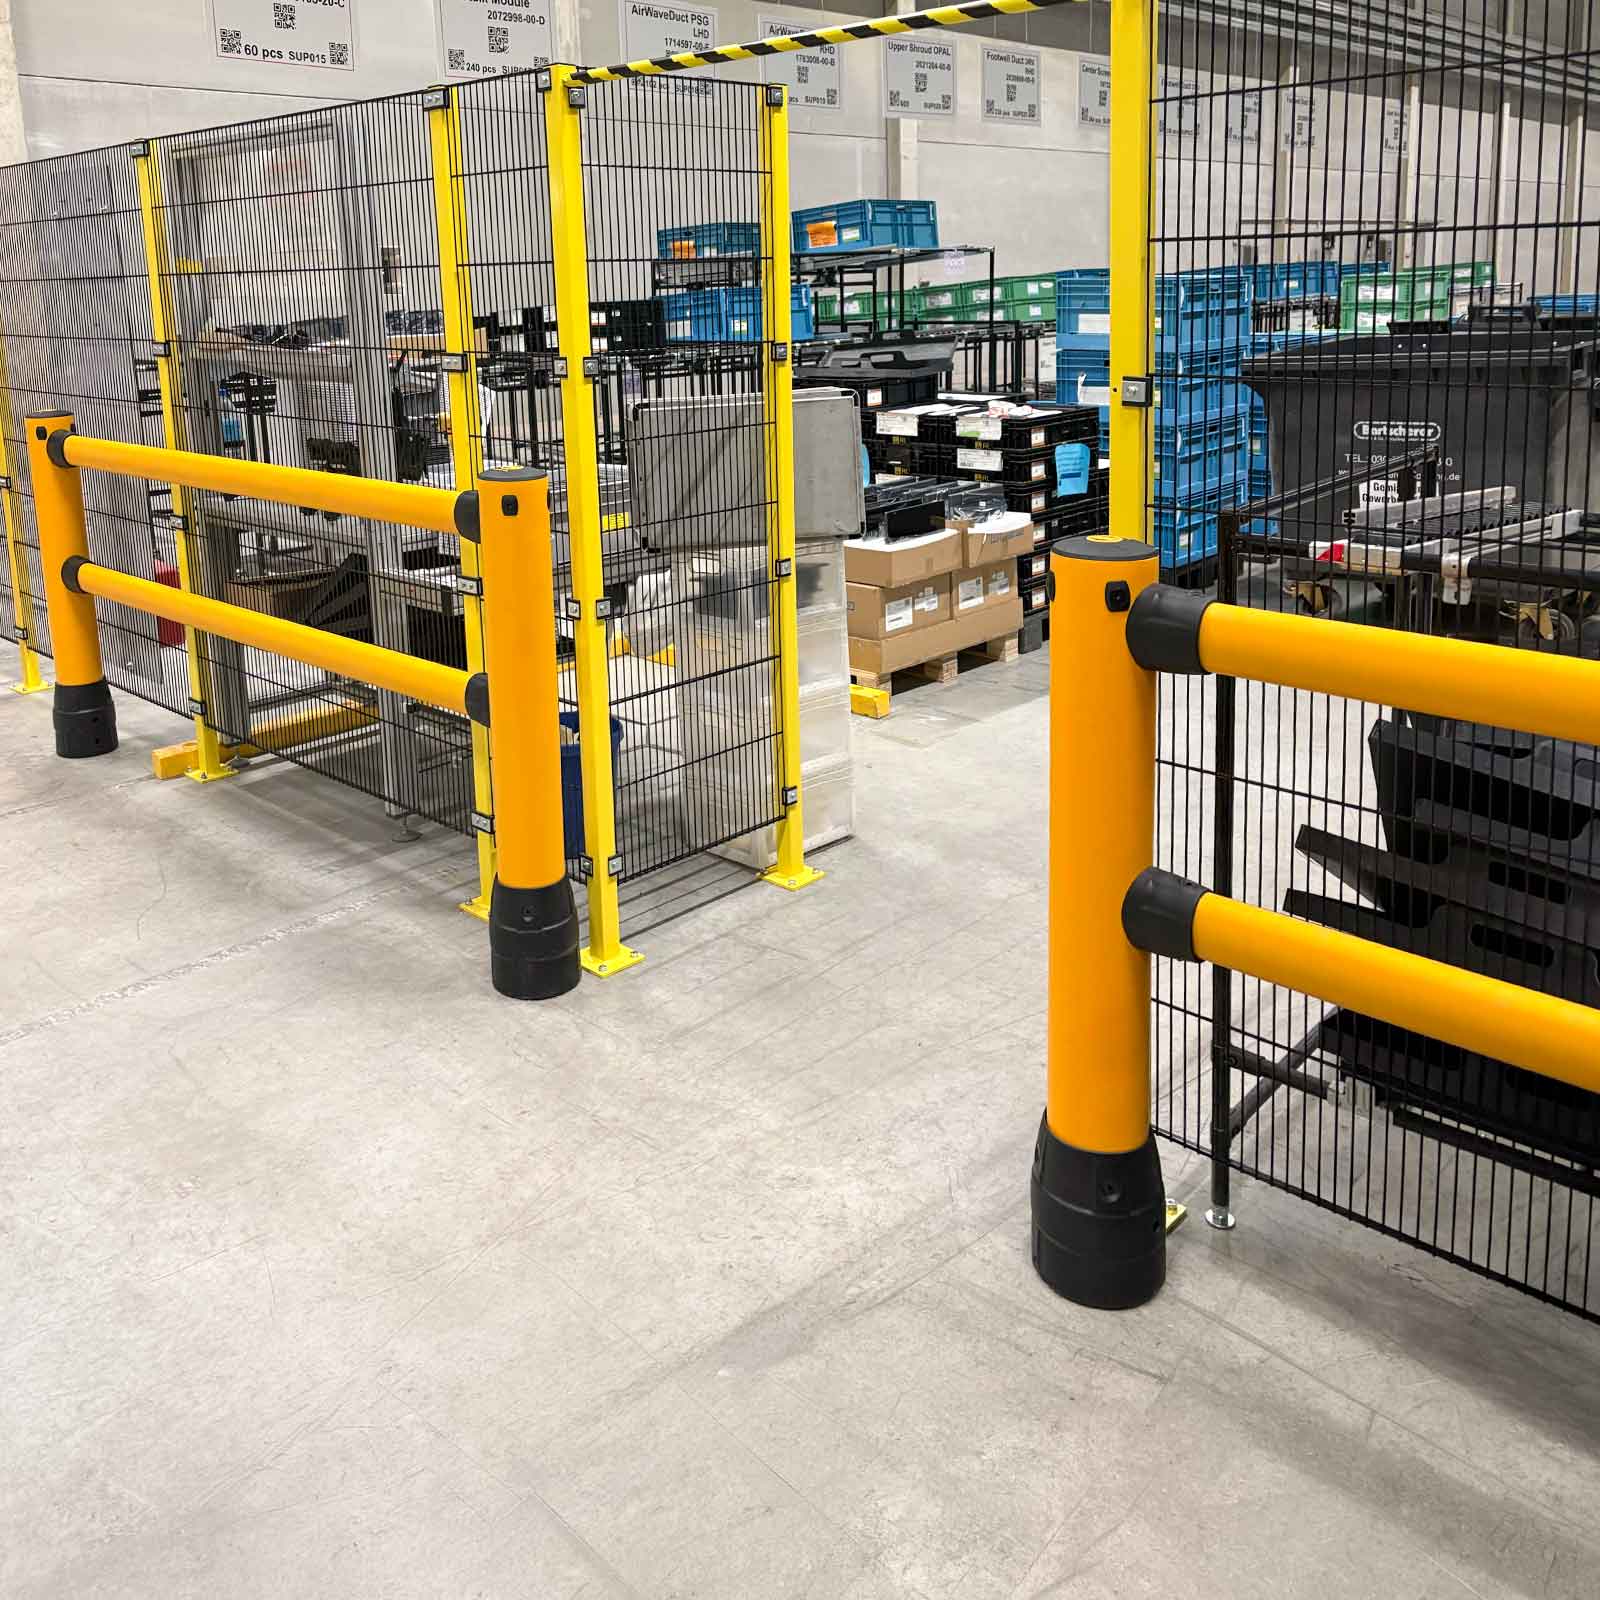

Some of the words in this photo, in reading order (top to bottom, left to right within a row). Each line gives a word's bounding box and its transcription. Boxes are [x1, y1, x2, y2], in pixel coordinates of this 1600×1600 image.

[487, 10, 545, 25] 2072998-00-D
[632, 4, 689, 23] AirWaveDuct
[691, 14, 709, 26] PSG
[693, 28, 709, 39] LHD
[244, 44, 258, 57] 60
[262, 48, 283, 59] pcs
[288, 51, 326, 63] SUP015
[888, 41, 908, 52] Upper
[909, 43, 932, 54] Shroud
[933, 46, 951, 56] OPAL
[466, 62, 480, 72] 240
[482, 65, 496, 76] pcs
